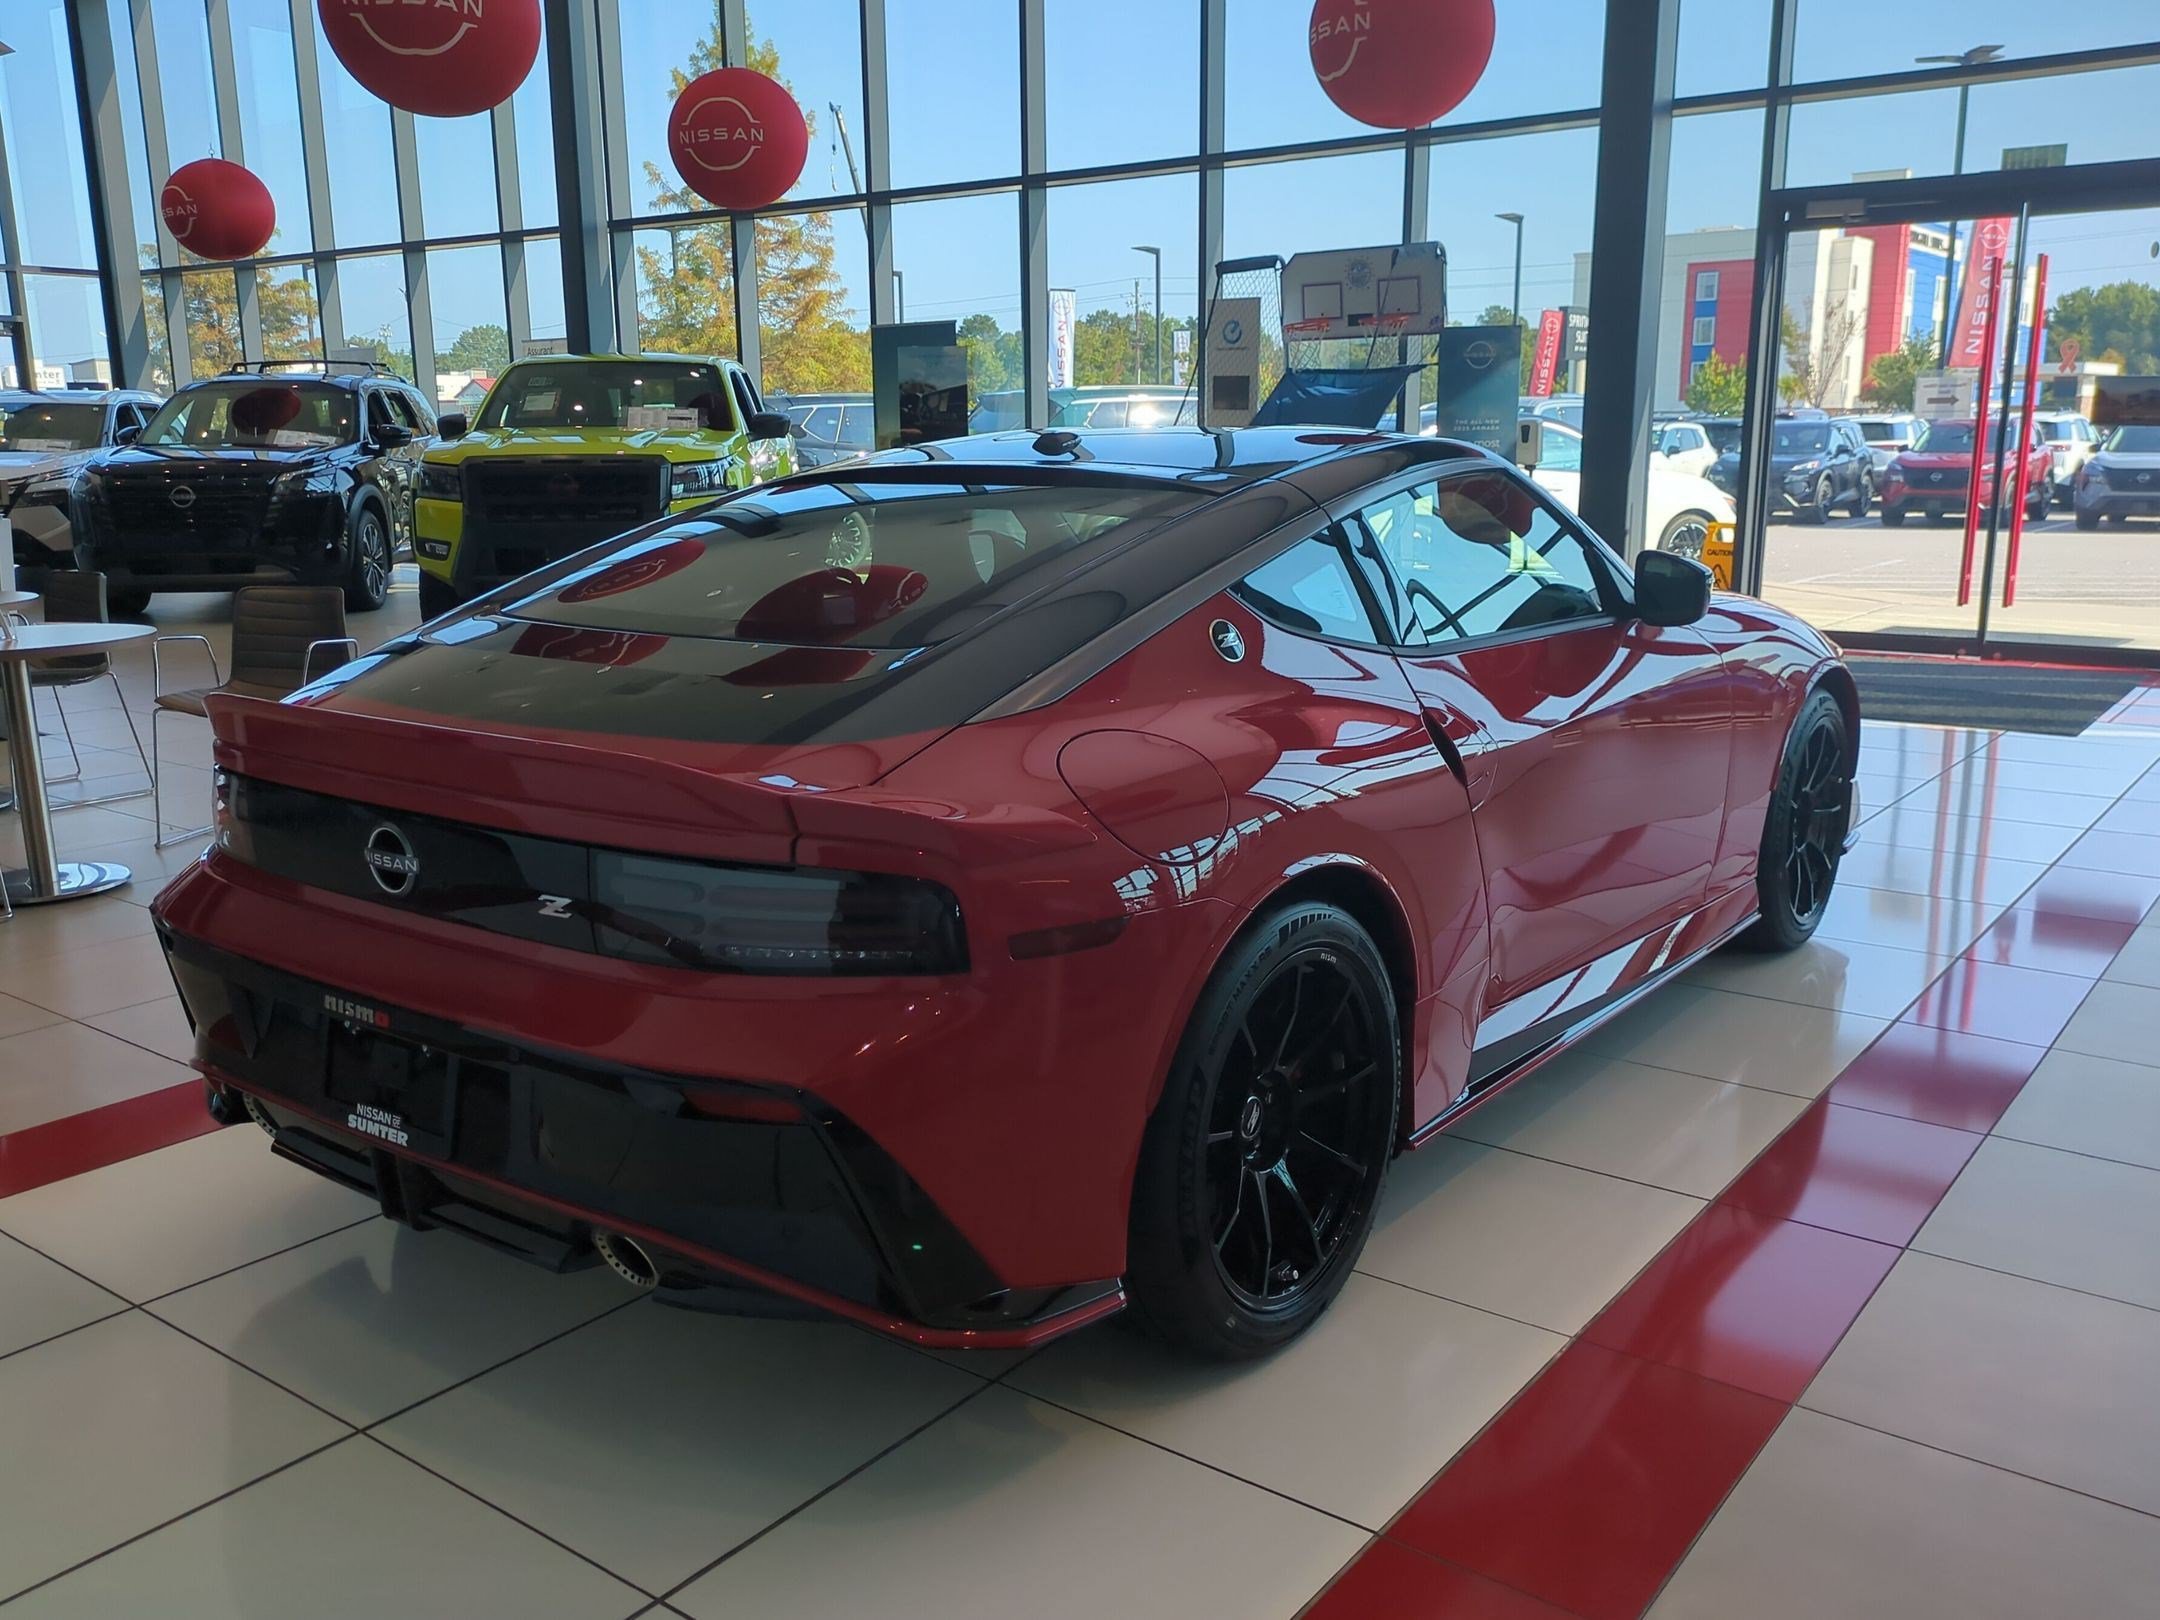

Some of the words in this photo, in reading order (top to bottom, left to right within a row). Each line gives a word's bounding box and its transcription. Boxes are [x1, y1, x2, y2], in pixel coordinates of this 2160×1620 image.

[679, 127, 764, 145] NISSAN
[1965, 255, 1994, 354] NISSAN
[1536, 336, 1555, 394] NISSAN
[537, 894, 572, 919] Z
[356, 1103, 392, 1126] NISSAN
[347, 1113, 409, 1147] SUMTER
